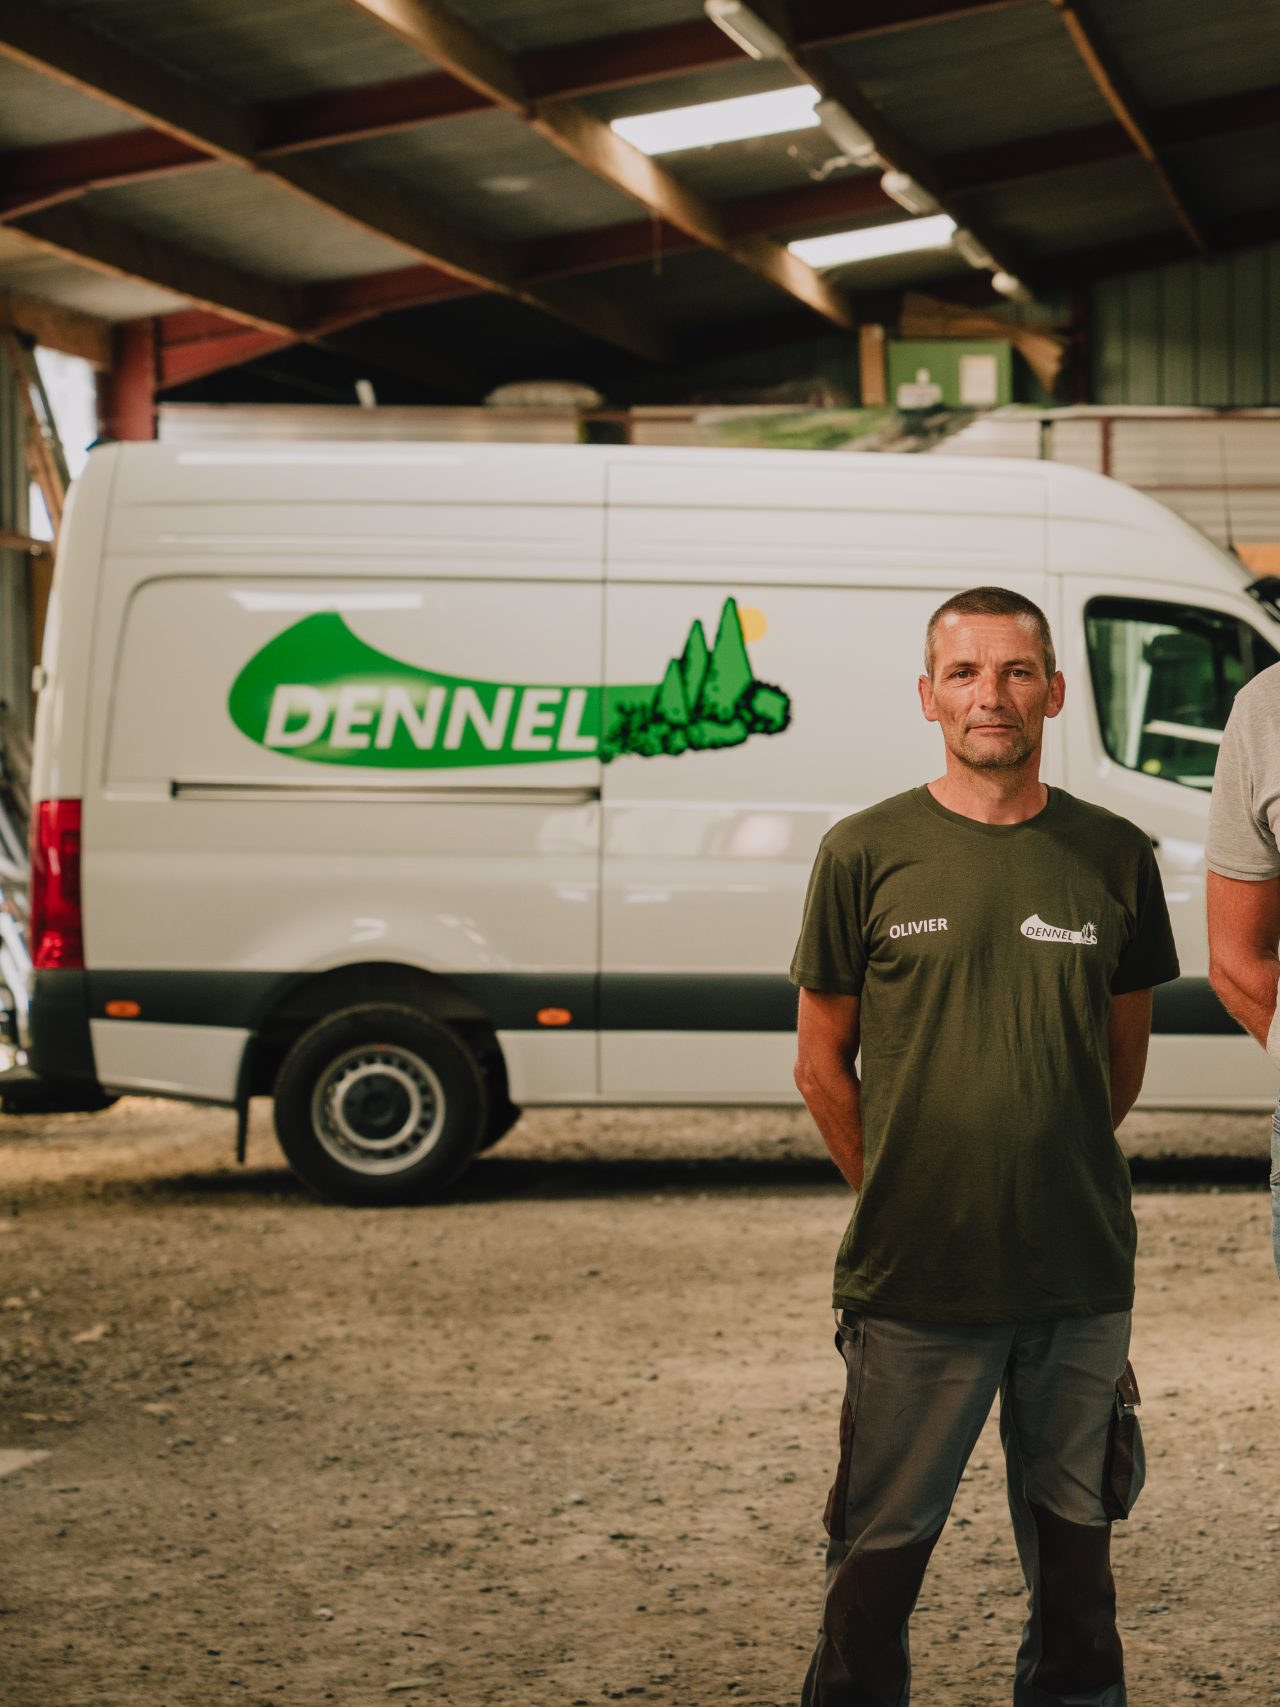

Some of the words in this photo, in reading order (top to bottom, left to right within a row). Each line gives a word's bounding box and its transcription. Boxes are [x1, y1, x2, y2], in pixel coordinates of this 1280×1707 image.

[263, 684, 599, 752] DENNEL
[889, 918, 948, 939] OLIVIER
[1026, 926, 1073, 941] DENNEL
